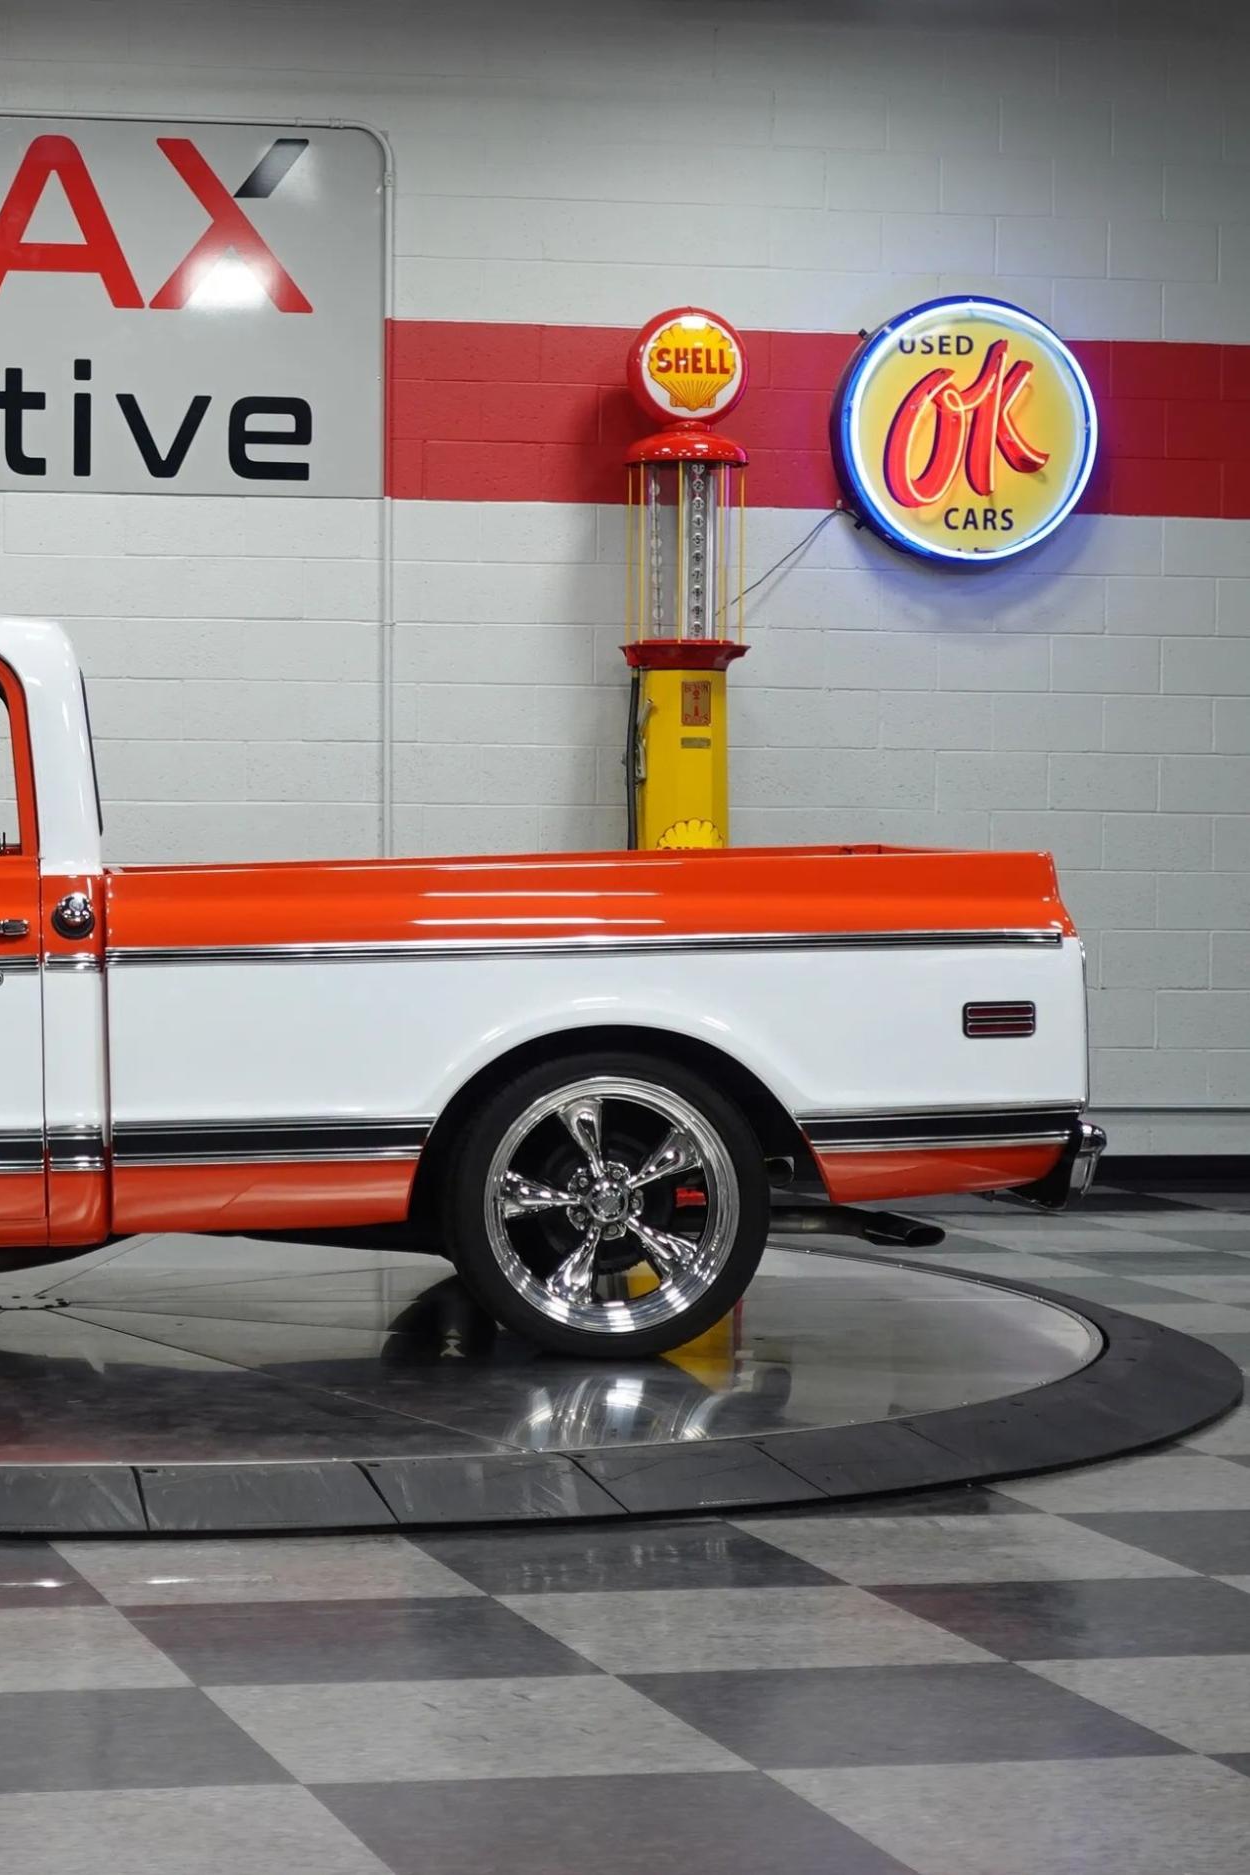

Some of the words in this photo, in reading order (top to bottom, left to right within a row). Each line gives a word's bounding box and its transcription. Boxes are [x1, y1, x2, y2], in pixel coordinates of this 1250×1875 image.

[899, 335, 974, 355] USED
[655, 347, 730, 375] SHELL
[883, 339, 1050, 508] OK
[944, 507, 1014, 531] CARS
